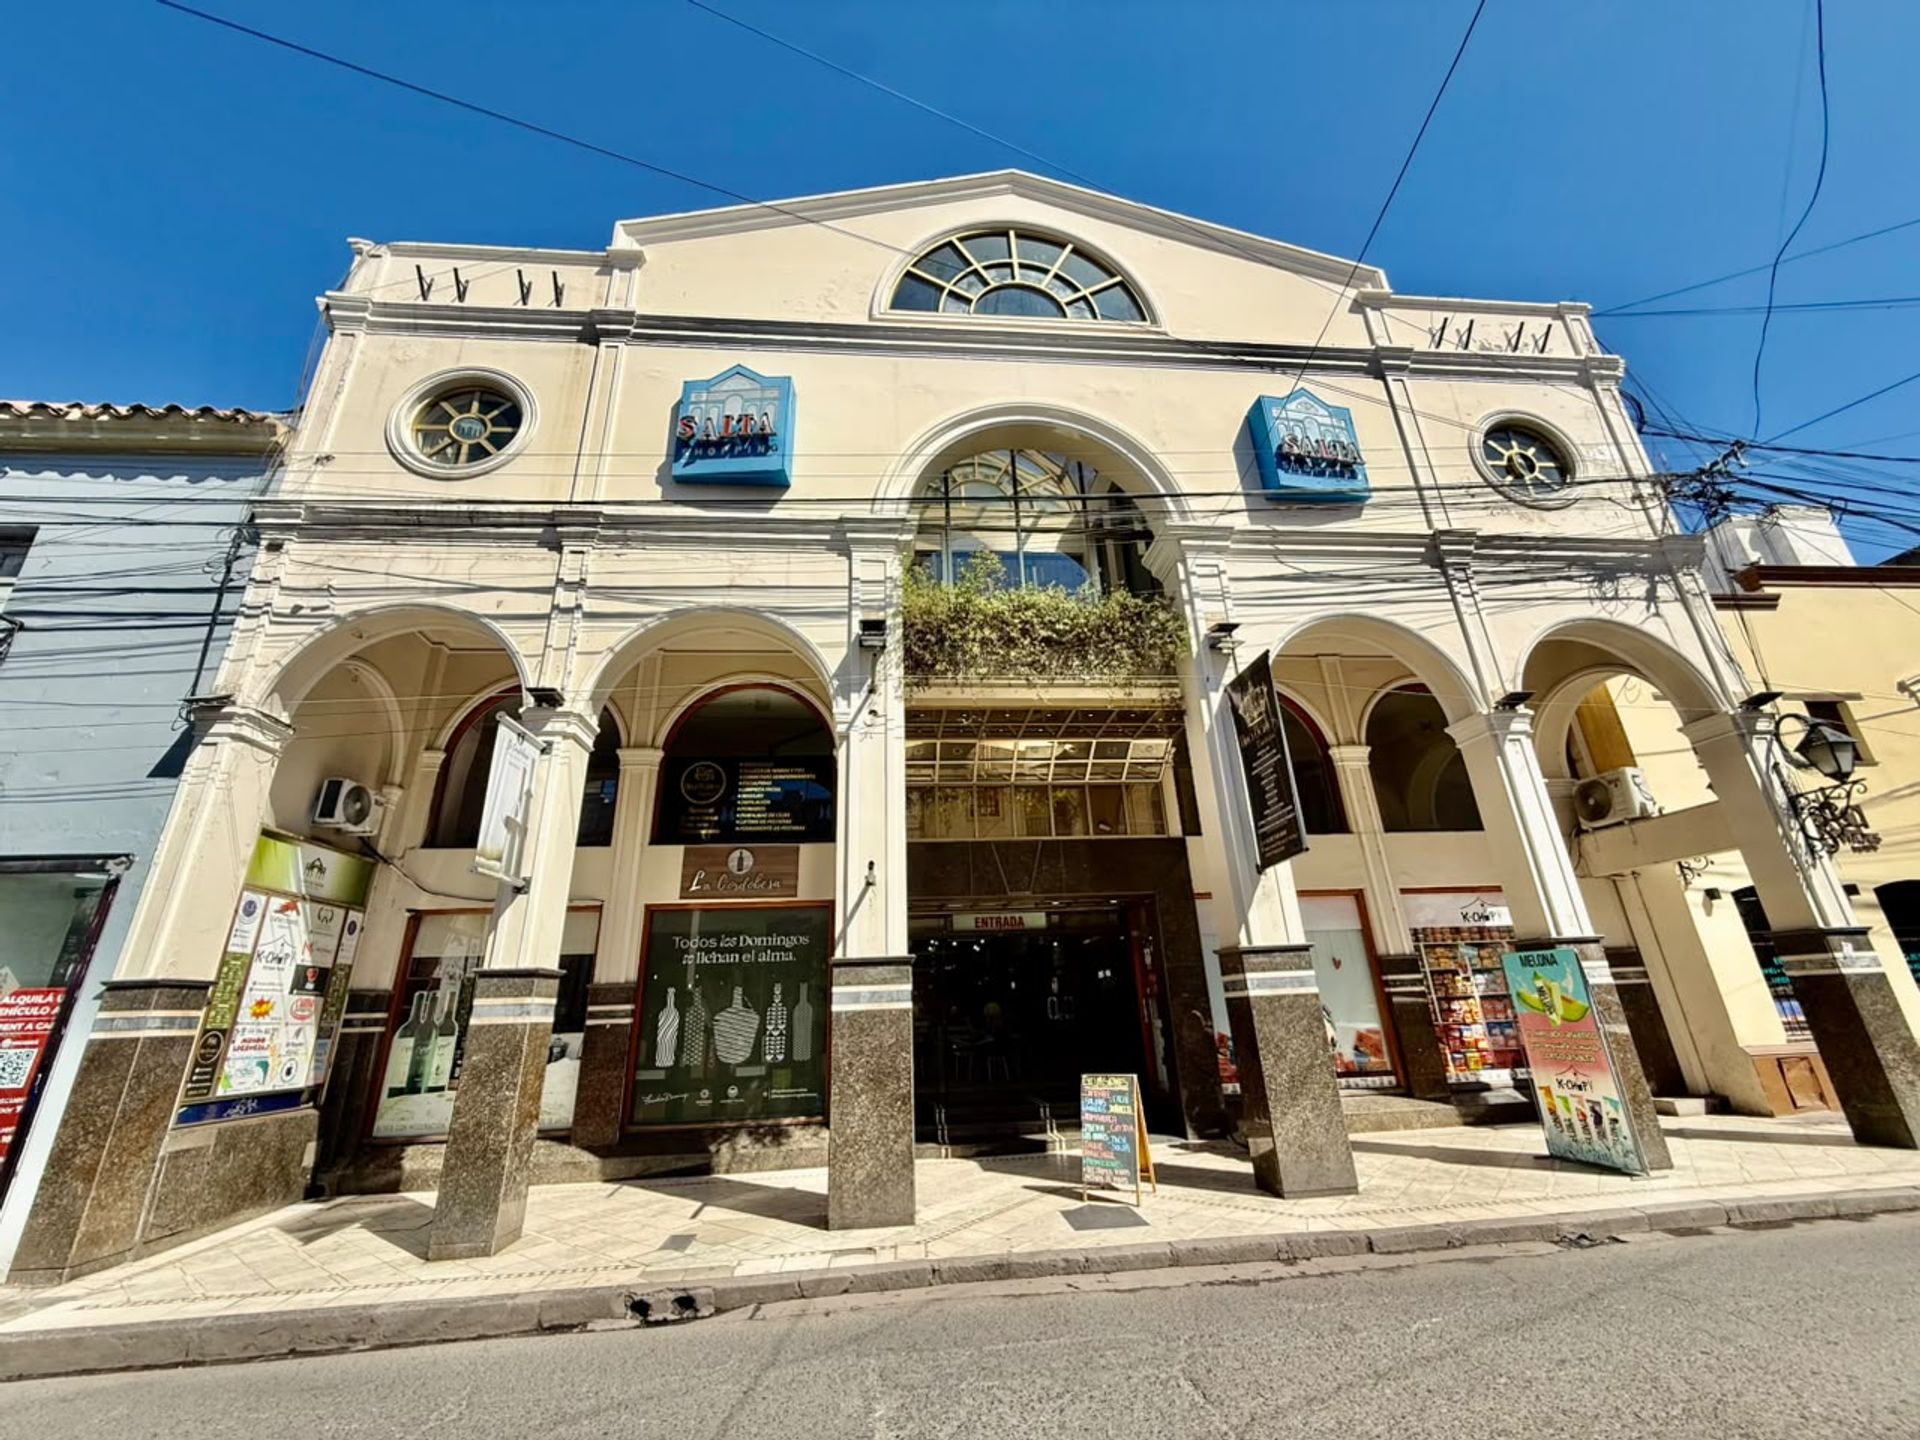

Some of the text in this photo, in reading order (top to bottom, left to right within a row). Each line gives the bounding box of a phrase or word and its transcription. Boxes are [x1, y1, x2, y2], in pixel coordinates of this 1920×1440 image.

[677, 412, 776, 441] SALTA
[1281, 433, 1366, 464] SALTA
[689, 870, 710, 892] La
[975, 916, 1025, 929] ENTRADA
[672, 933, 809, 949] Todos los Domingos
[742, 949, 755, 963] el
[758, 949, 797, 963] alma.
[1518, 953, 1559, 968] MELONA
